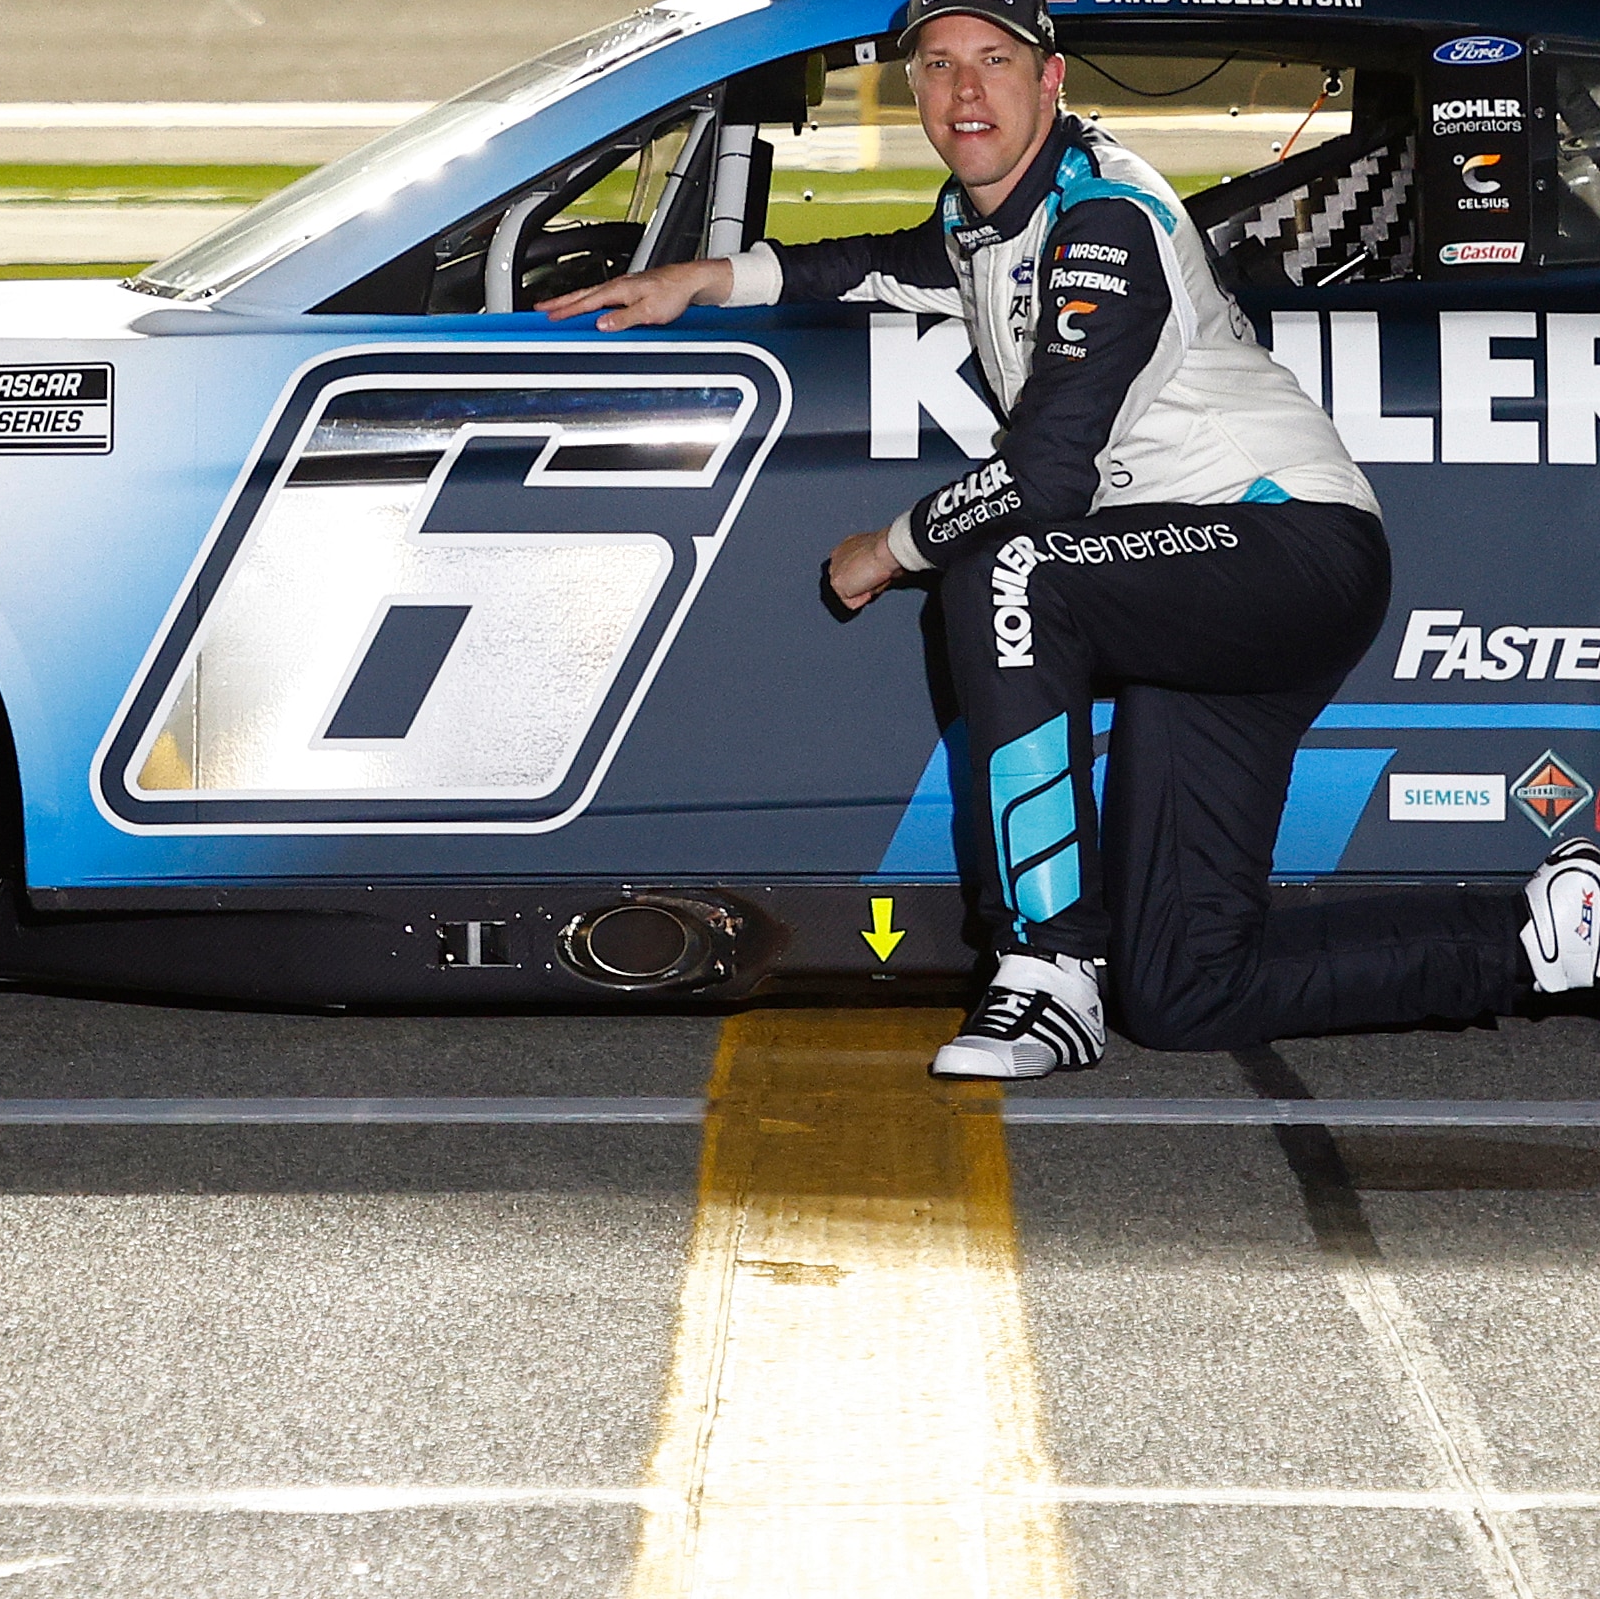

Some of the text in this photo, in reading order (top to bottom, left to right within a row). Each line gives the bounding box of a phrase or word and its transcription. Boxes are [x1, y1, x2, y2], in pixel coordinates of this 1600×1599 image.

[1450, 38, 1505, 62] Ford
[1433, 99, 1523, 122] KOHLER
[1433, 119, 1522, 136] Generators
[1458, 198, 1510, 210] CELSIUS
[1067, 243, 1129, 266] NASCAR
[1459, 243, 1518, 261] Castrol
[1048, 267, 1129, 296] FASTENAL
[1047, 342, 1087, 359] CELSIUS
[927, 489, 1022, 544] Generators
[89, 341, 794, 837] 6
[992, 522, 1239, 669] KOHLER Generators
[1404, 788, 1491, 806] SIEMENS
